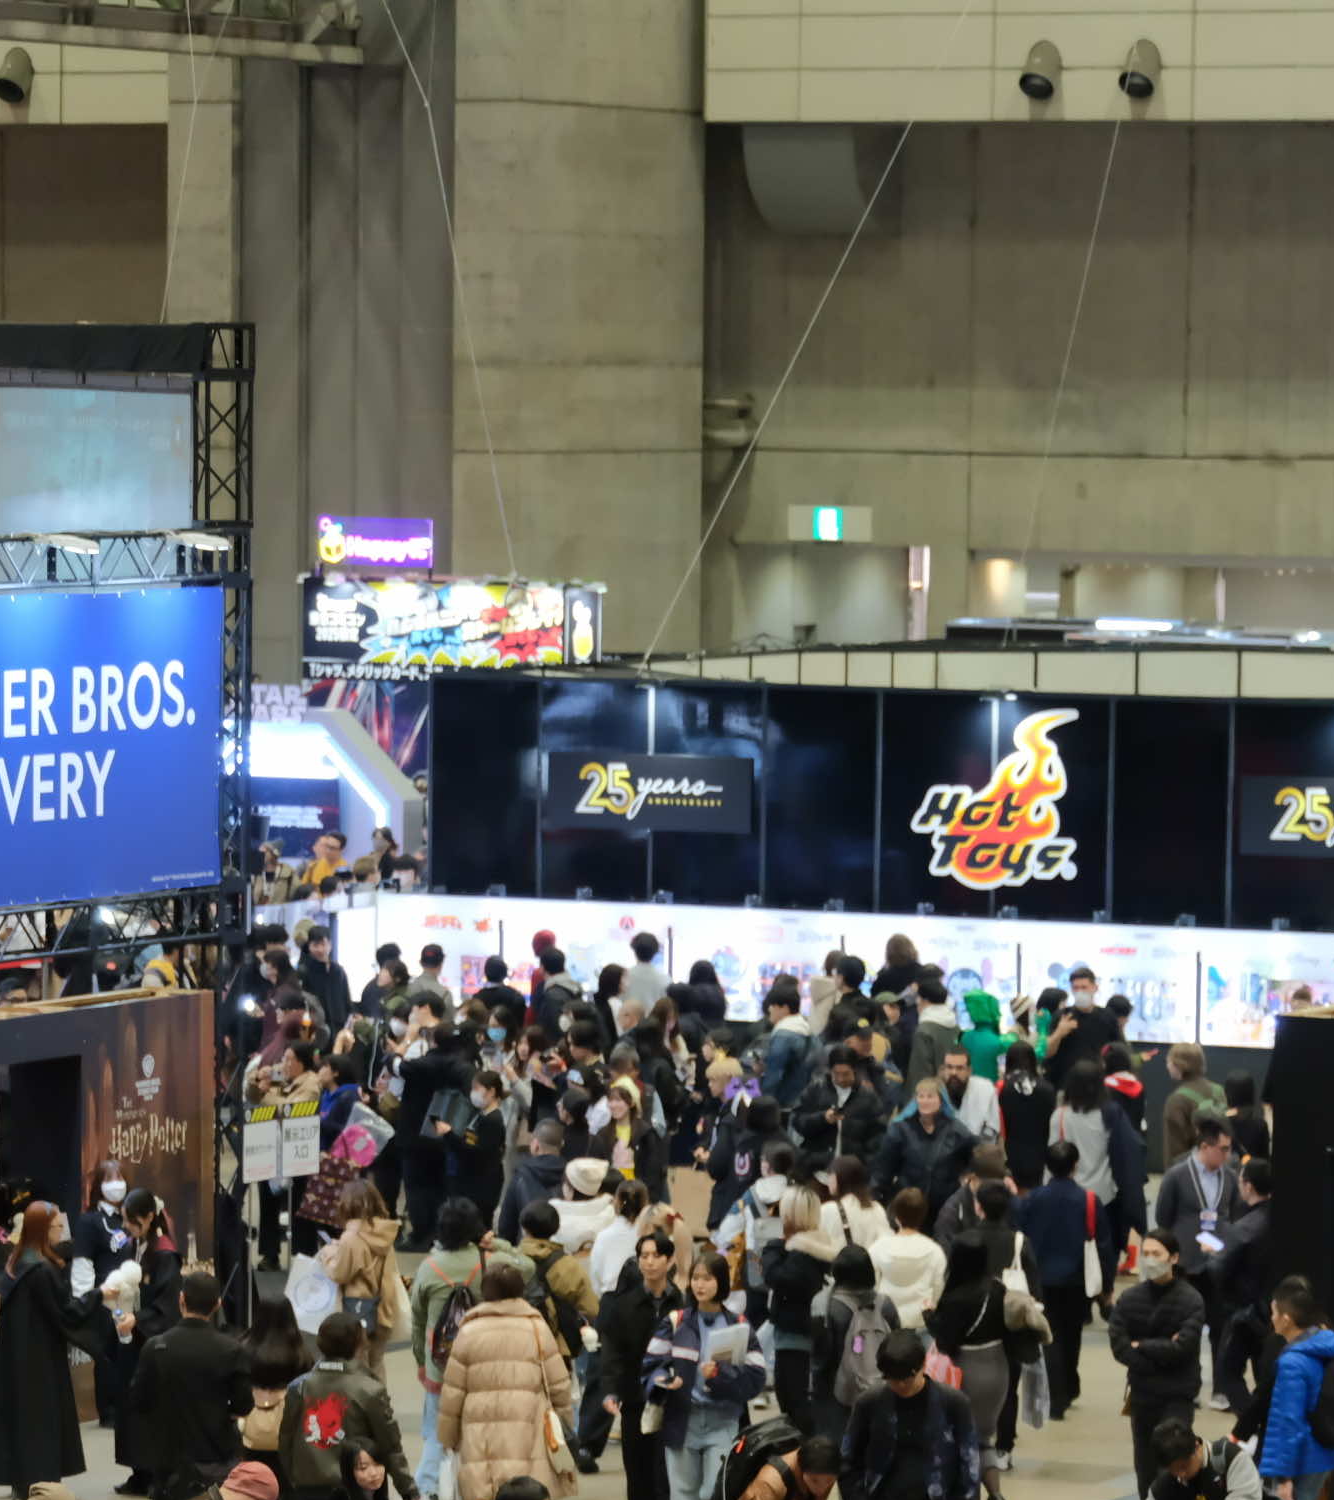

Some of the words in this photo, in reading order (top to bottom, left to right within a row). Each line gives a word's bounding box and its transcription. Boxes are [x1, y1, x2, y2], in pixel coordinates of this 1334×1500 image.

[71, 659, 196, 734] BROS.
[251, 684, 303, 705] TAR
[575, 761, 636, 815] 25
[625, 776, 724, 821] years
[917, 790, 1027, 830] Hot
[935, 833, 1069, 880] Toys
